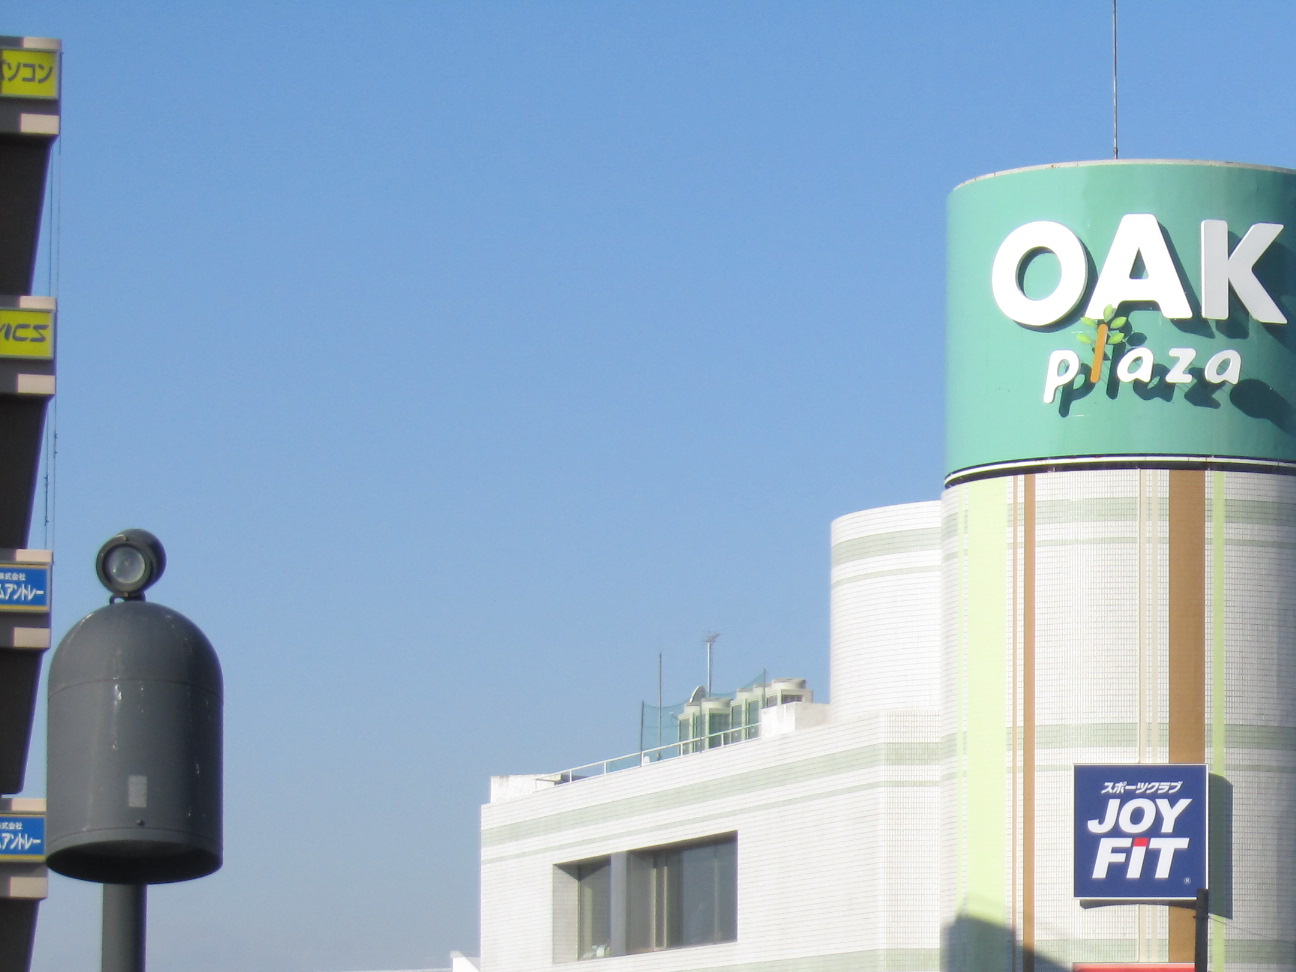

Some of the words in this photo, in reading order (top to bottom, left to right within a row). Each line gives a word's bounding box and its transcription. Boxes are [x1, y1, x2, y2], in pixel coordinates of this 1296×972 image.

[991, 213, 1288, 326] OAK
[1043, 323, 1242, 403] plaza
[1087, 798, 1192, 833] JOY
[1101, 781, 1183, 793] スポーツクラブ
